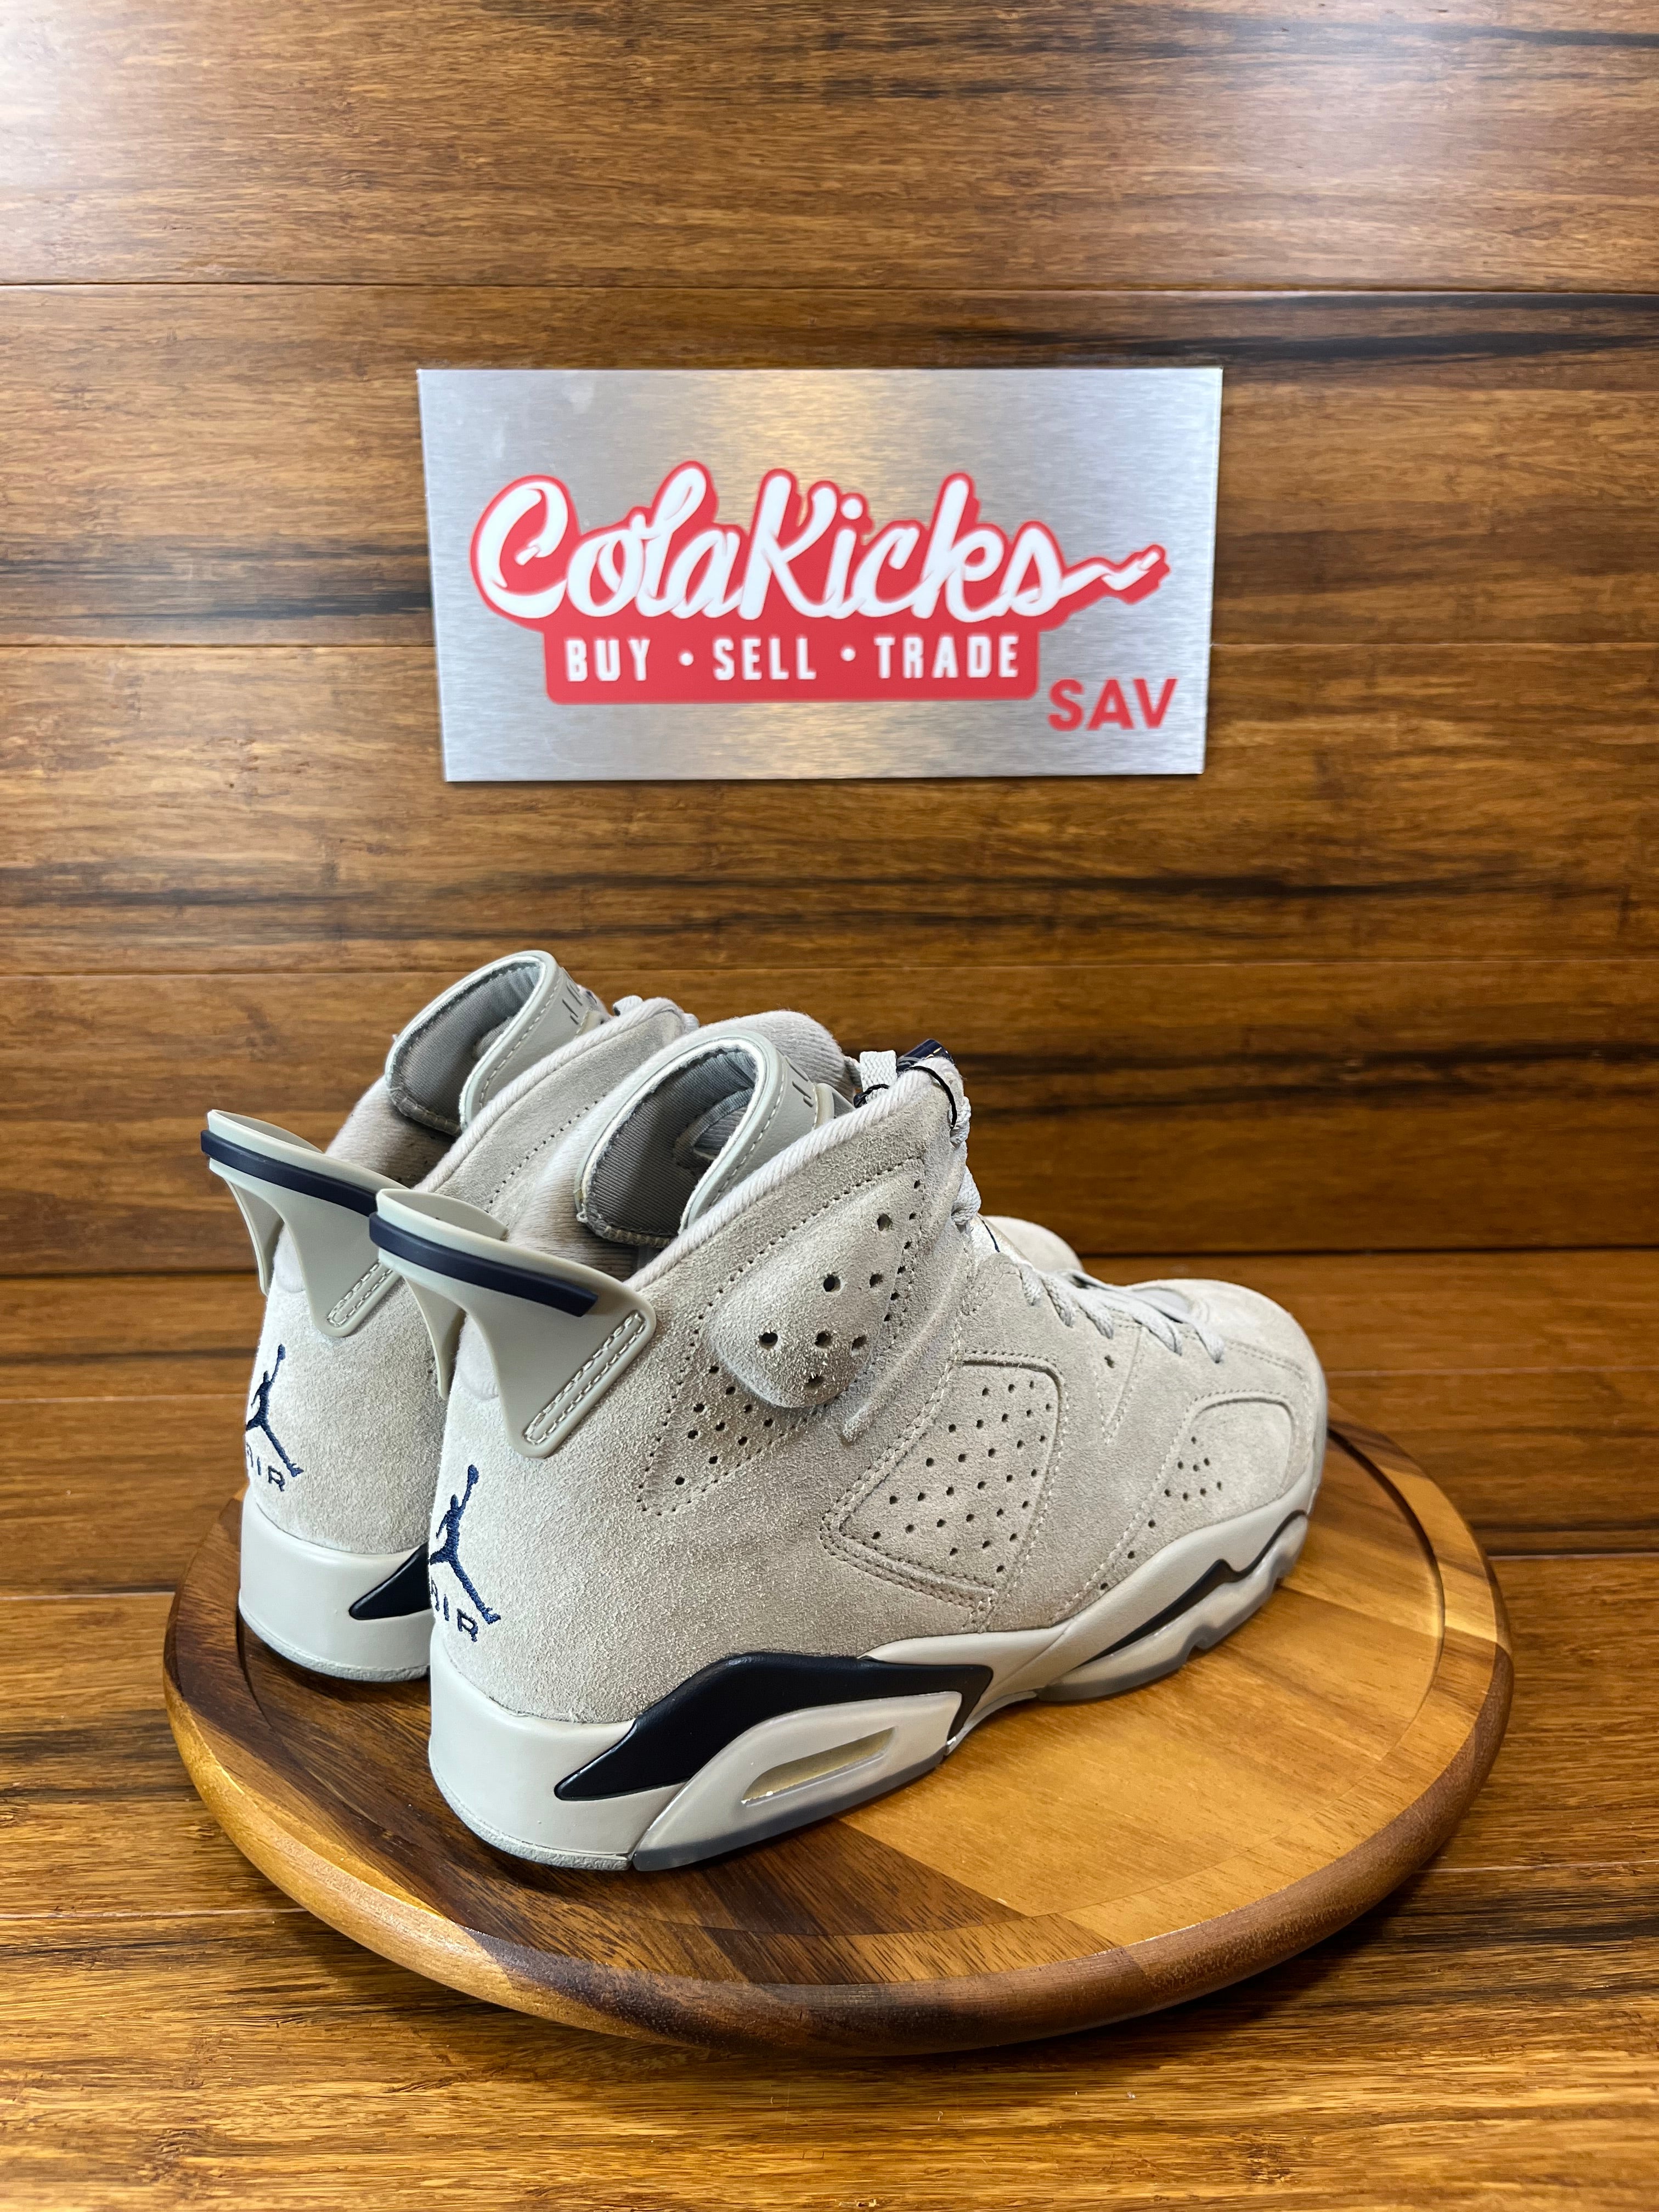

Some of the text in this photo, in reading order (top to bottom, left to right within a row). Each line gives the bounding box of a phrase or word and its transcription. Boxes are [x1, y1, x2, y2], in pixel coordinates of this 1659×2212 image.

[475, 462, 1161, 621] ColaKicks
[566, 633, 1020, 682] BUY SELL TRADE
[1048, 678, 1177, 730] SAV
